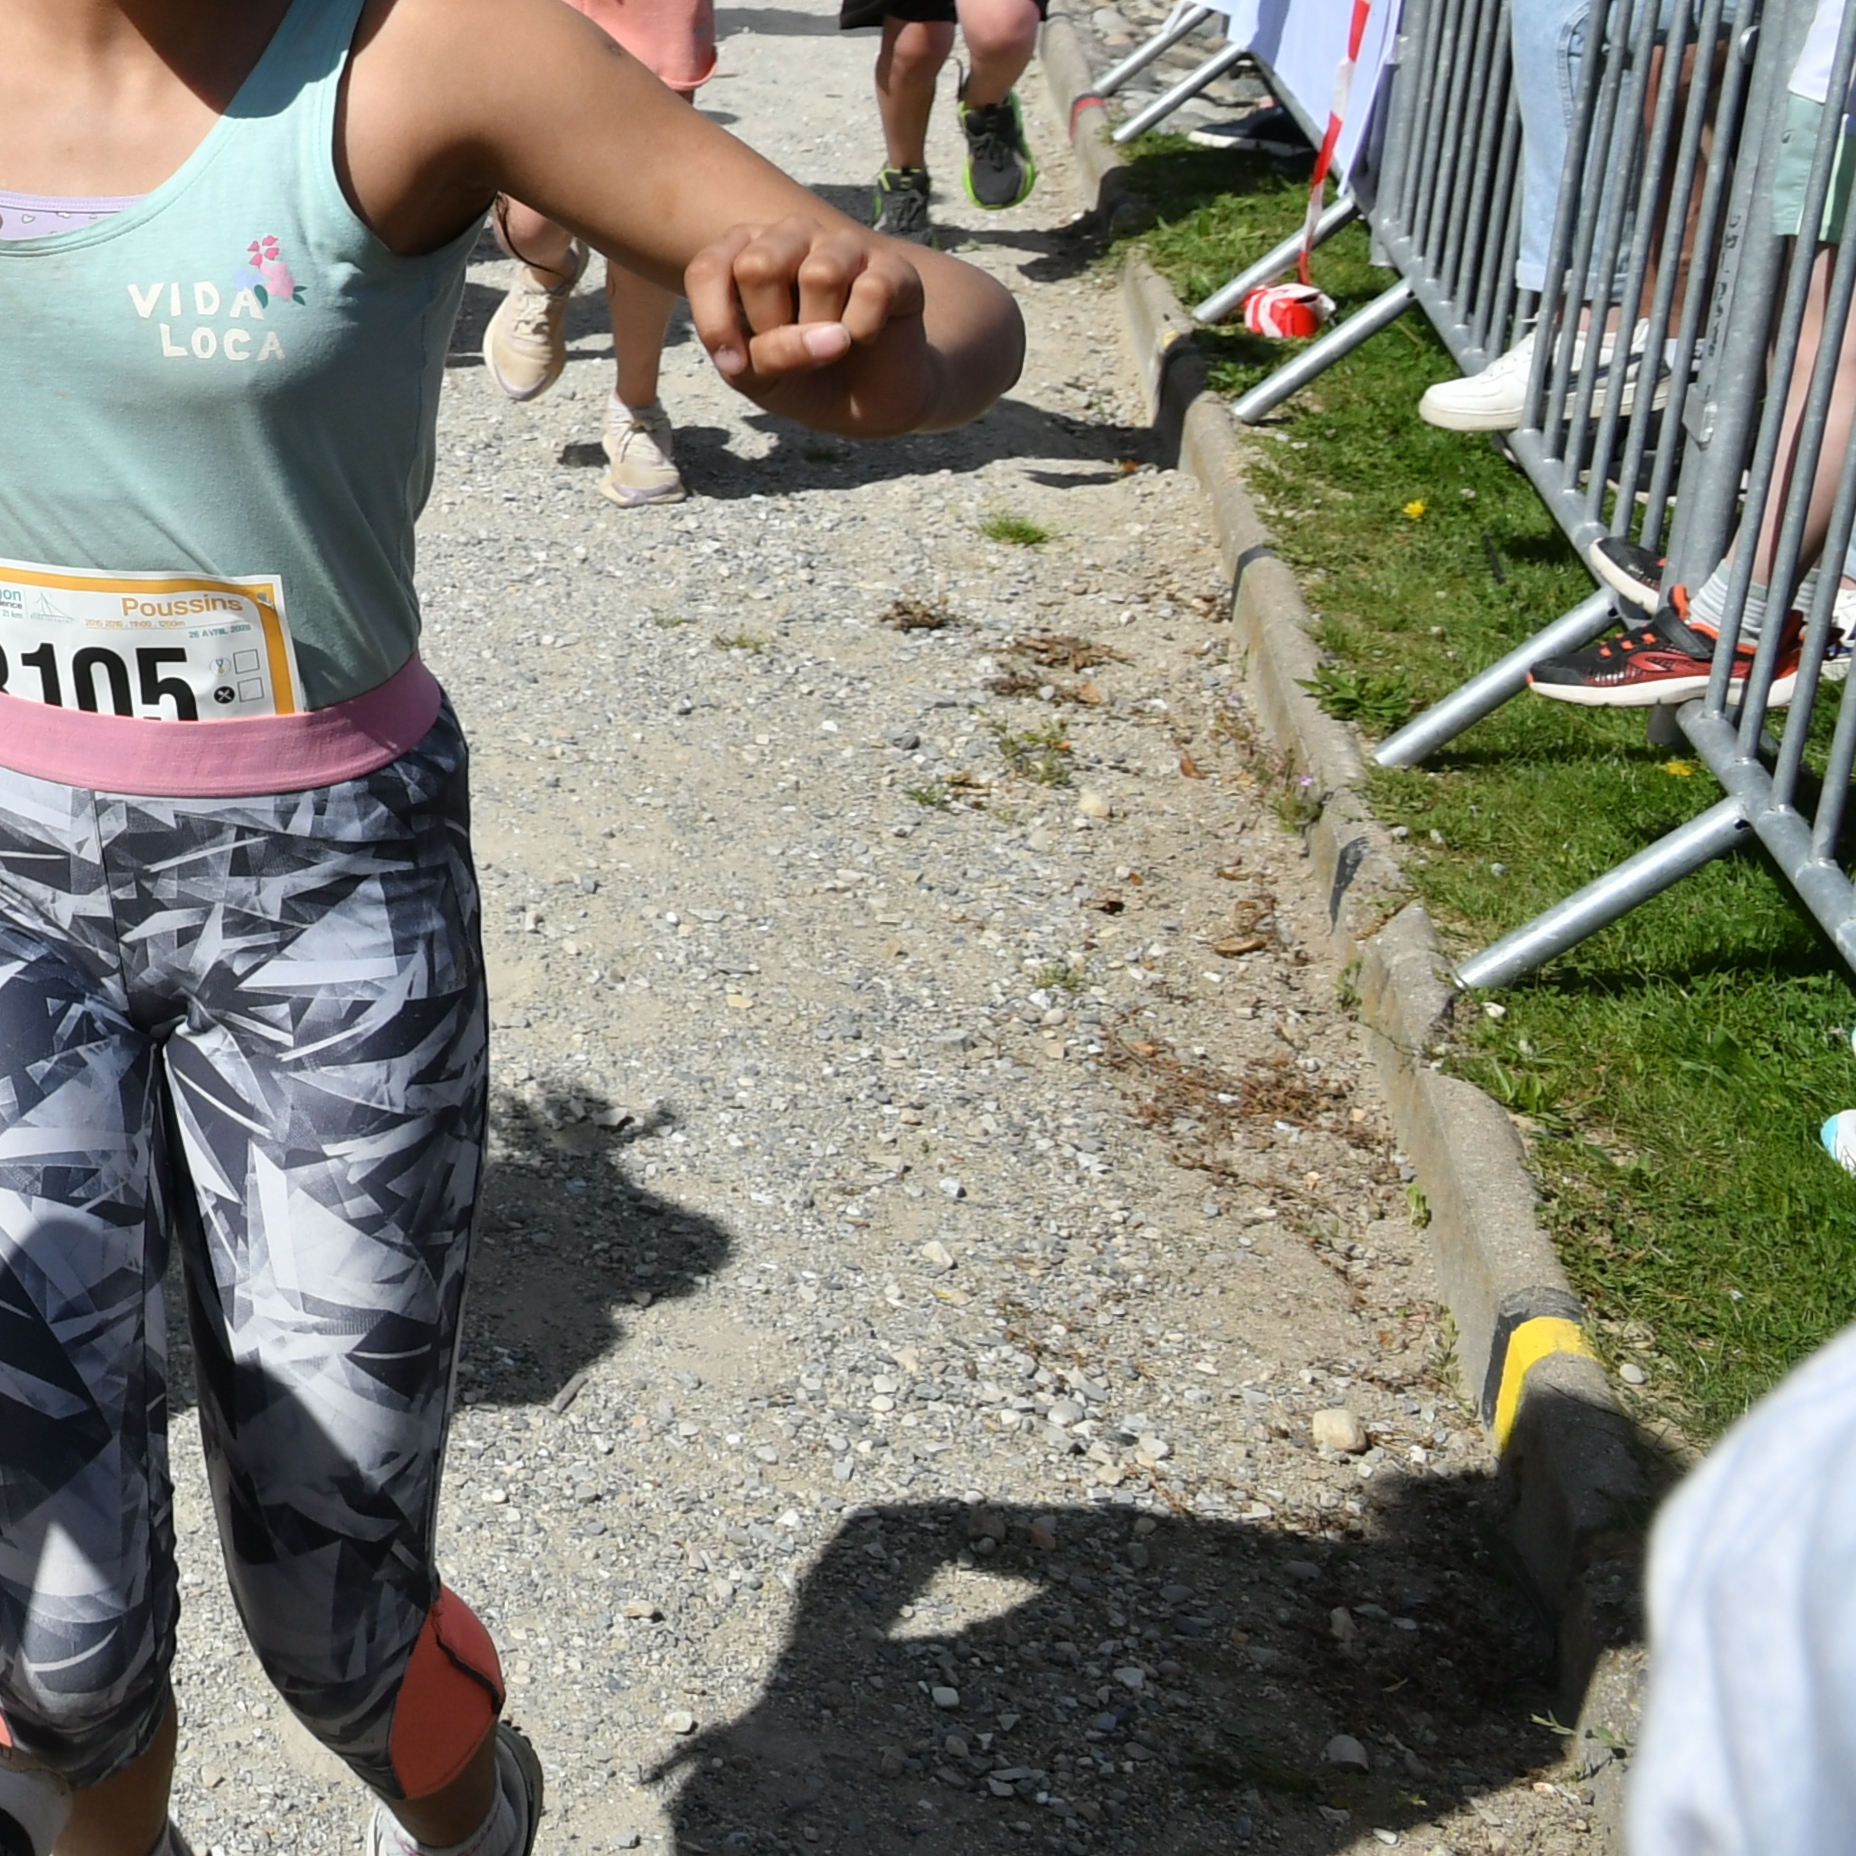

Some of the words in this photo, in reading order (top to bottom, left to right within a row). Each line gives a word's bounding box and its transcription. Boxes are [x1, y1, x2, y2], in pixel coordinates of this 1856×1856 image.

[127, 281, 265, 320] VIDA
[159, 322, 286, 362] LOCA
[121, 594, 243, 617] Poussins
